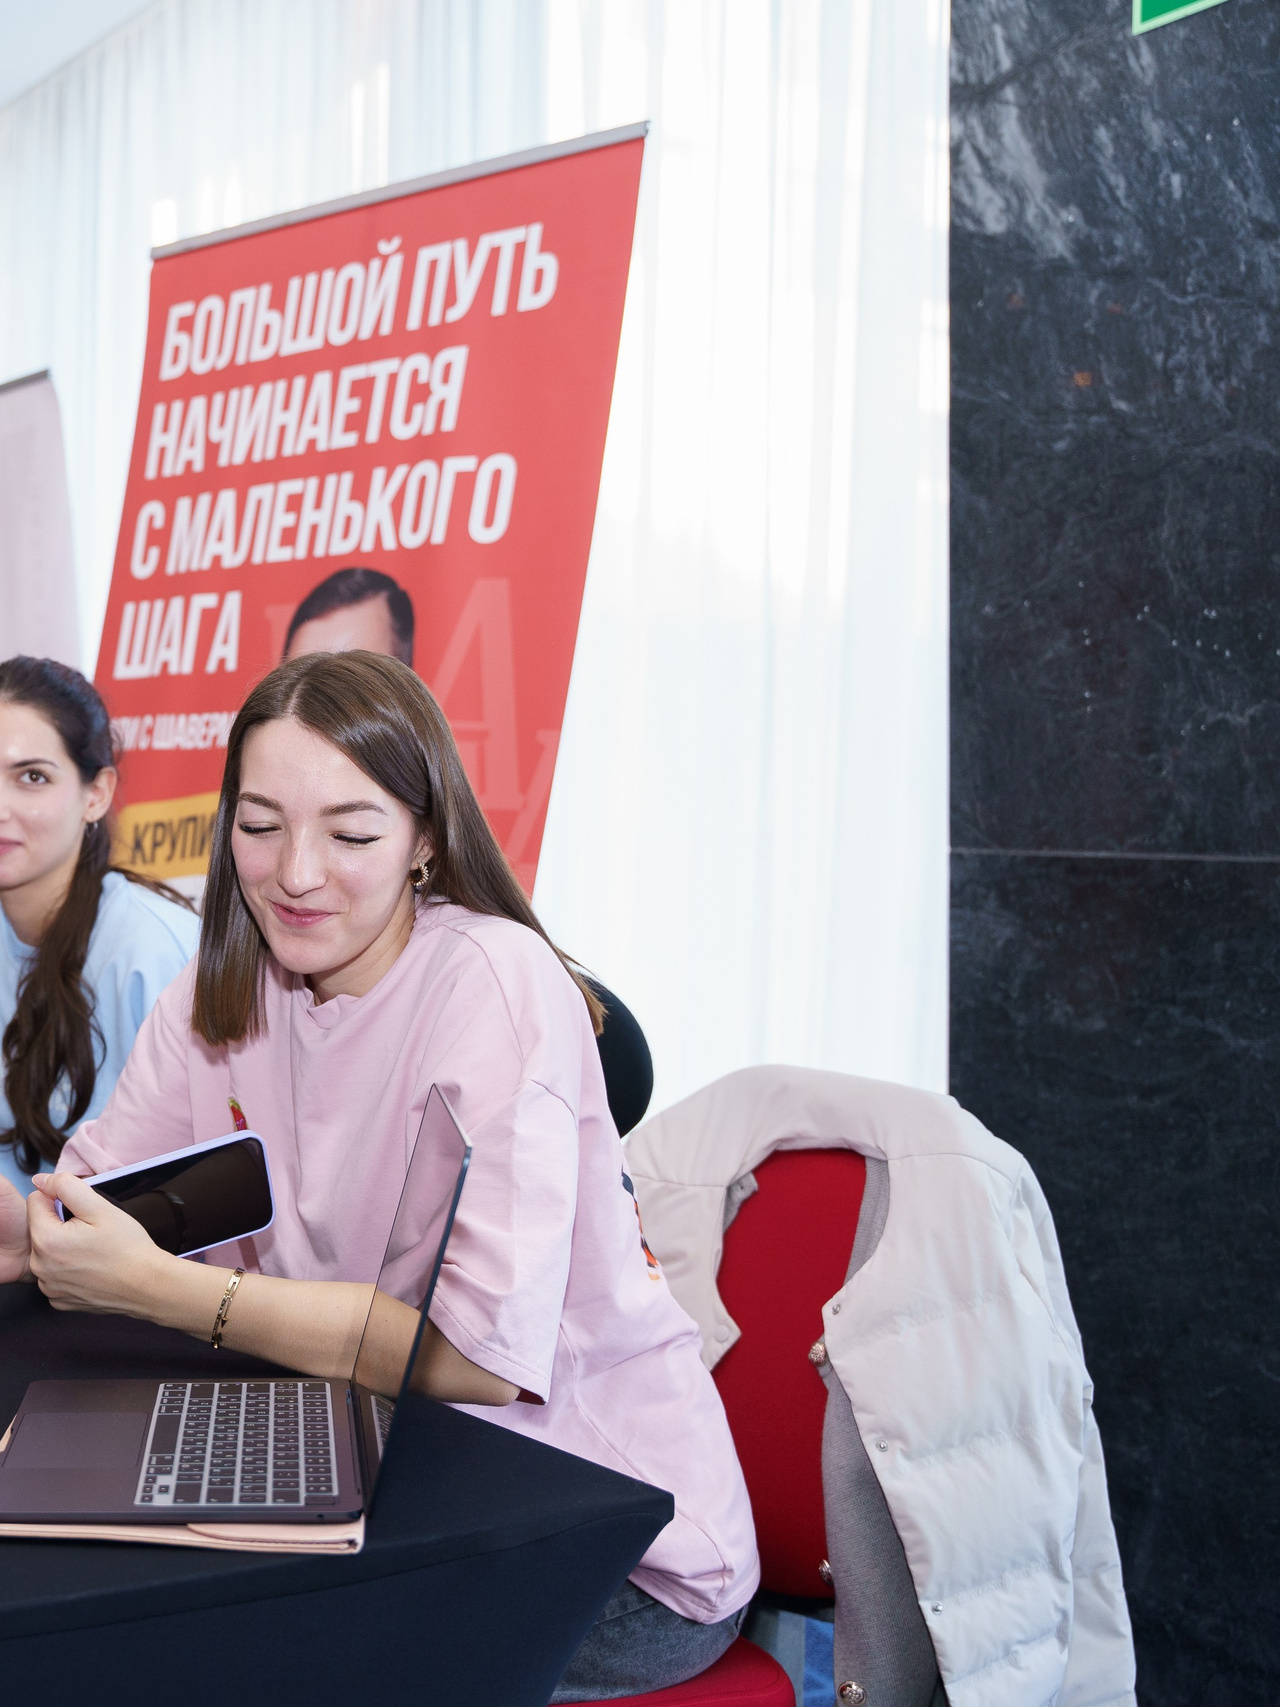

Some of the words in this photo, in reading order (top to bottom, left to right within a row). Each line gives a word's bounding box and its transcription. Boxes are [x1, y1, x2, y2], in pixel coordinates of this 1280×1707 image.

[159, 236, 403, 381] БОЛЬШОЙ
[406, 222, 559, 332] ПУТЬ
[144, 345, 469, 480] НАЧИНАЕТСЯ
[130, 500, 165, 579] С
[165, 453, 517, 576] МАЛЕНЬКОГО
[112, 590, 241, 680] ШАГА
